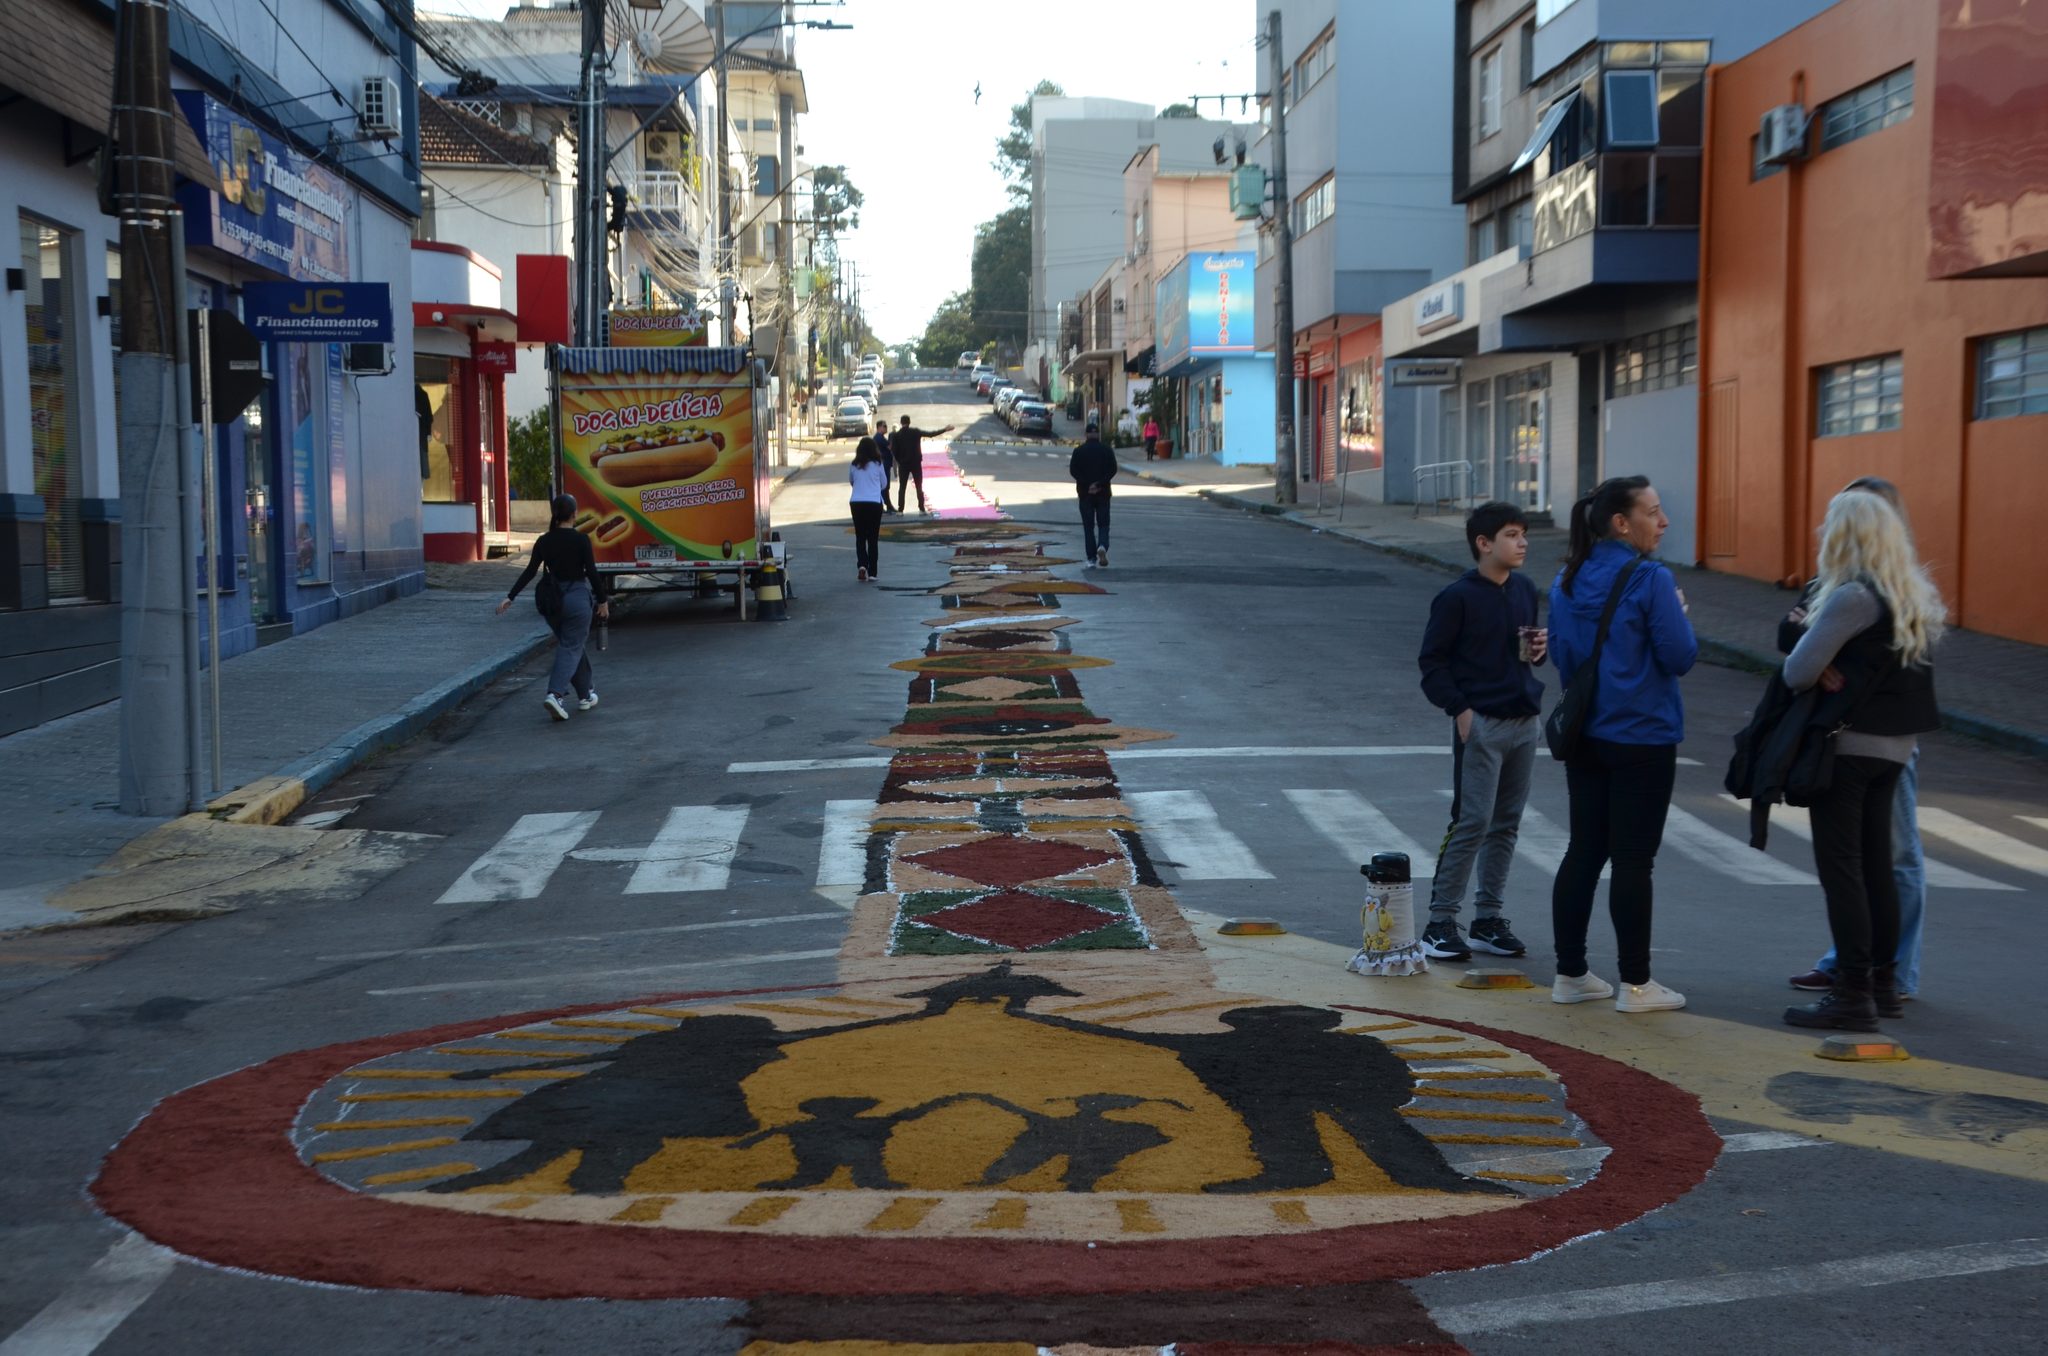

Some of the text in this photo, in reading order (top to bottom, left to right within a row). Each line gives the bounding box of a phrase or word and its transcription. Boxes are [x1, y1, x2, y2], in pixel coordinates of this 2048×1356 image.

[219, 121, 266, 216] JC
[264, 150, 344, 225] Financiamentos
[288, 288, 345, 314] JC
[1219, 272, 1229, 345] DENTISTAS
[256, 315, 379, 328] Financiamentos
[614, 316, 640, 331] DOG
[573, 392, 724, 436] DOG KI-DELÍCIA
[640, 479, 736, 501] O VERDADEIRO SABOR
[642, 501, 656, 513] DO
[656, 494, 706, 510] CACHORRO
